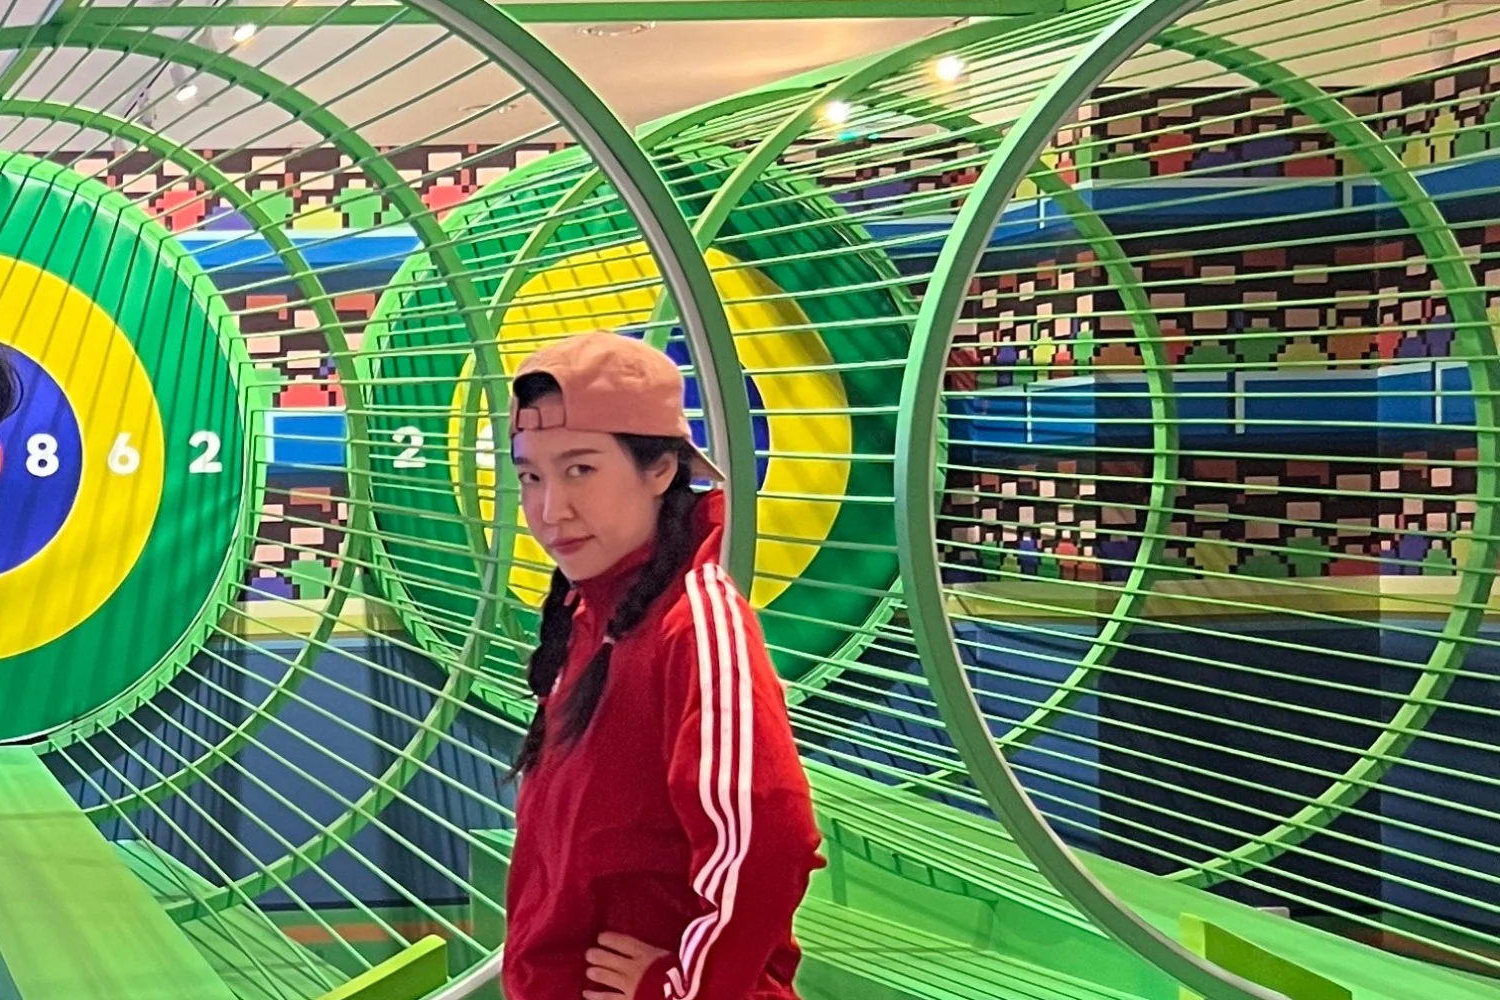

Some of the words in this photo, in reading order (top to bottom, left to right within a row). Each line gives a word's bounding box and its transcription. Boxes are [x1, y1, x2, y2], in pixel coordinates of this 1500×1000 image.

[25, 433, 59, 477] 8
[107, 431, 140, 474] 6
[188, 430, 223, 474] 2
[391, 426, 426, 468] 2
